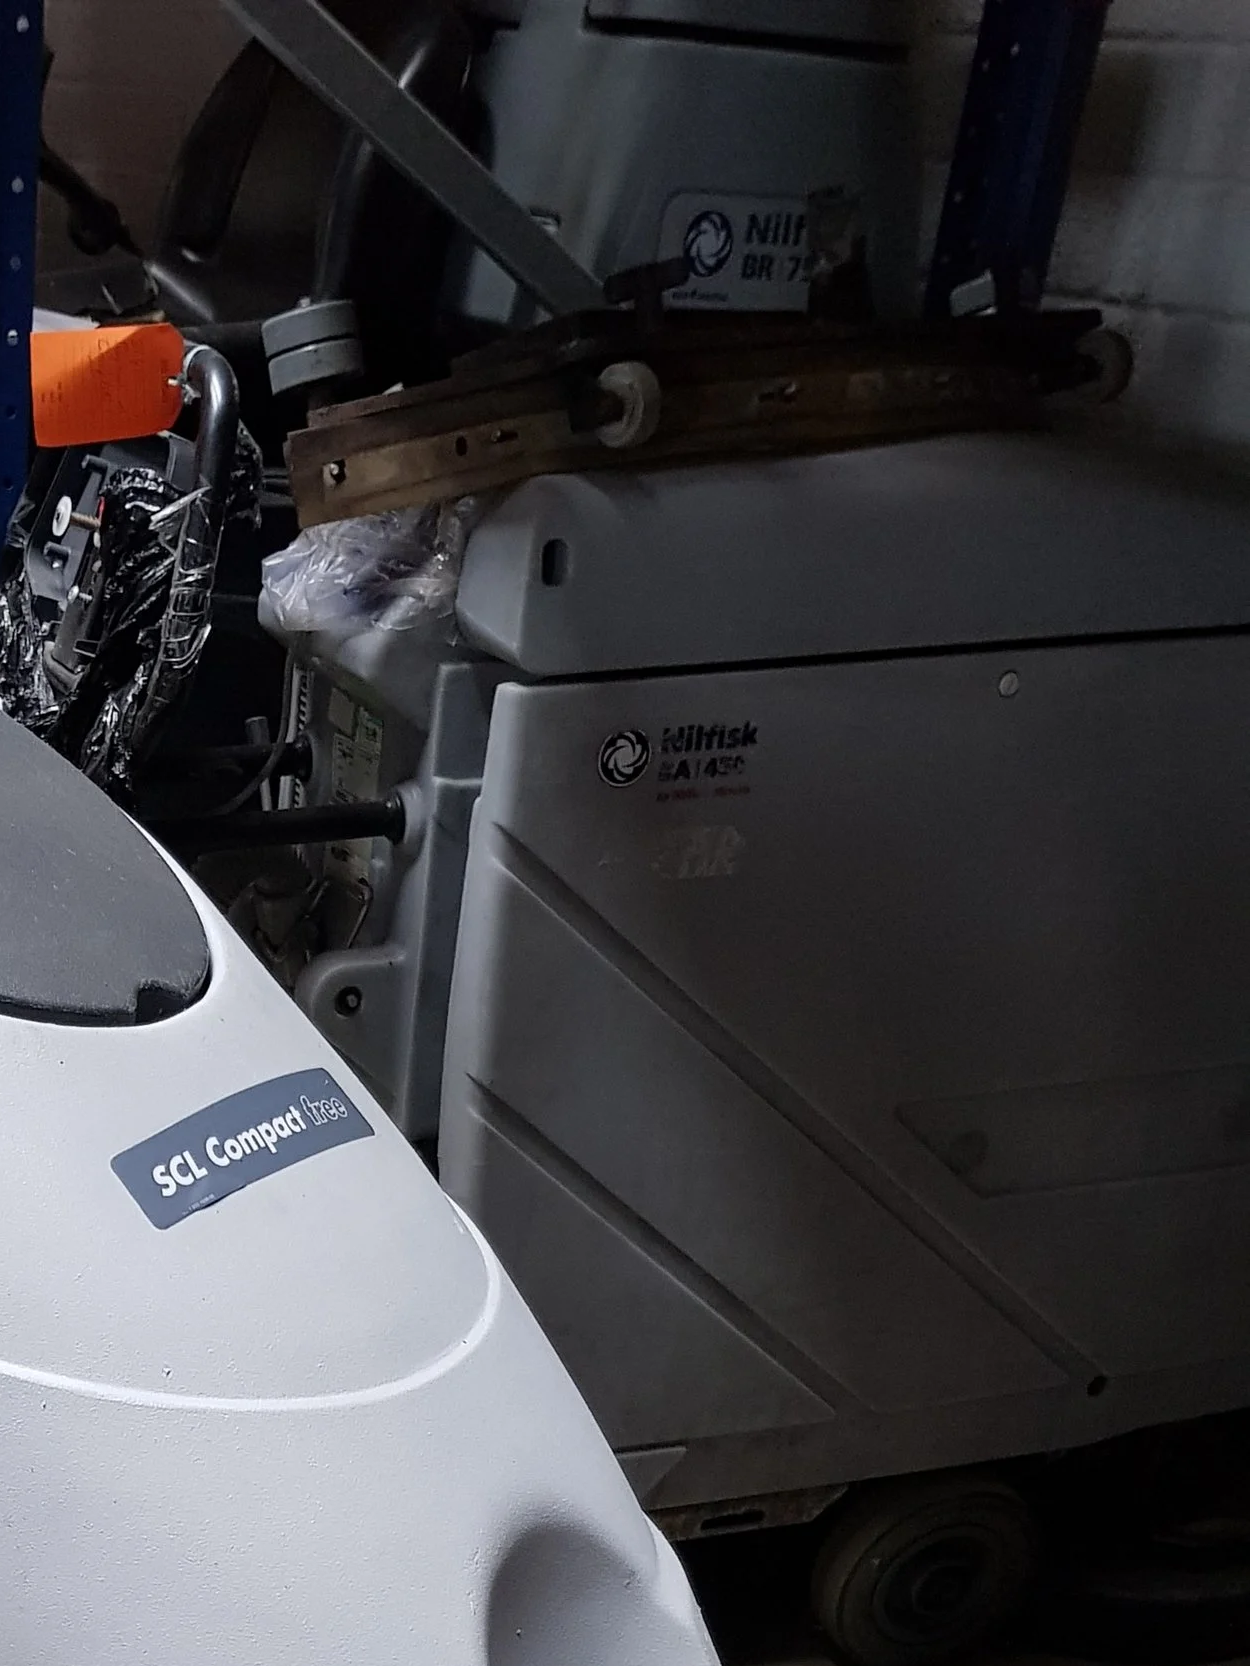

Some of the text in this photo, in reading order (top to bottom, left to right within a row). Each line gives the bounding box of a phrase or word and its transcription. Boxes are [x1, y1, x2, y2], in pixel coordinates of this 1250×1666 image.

[746, 212, 806, 247] Nilf
[741, 254, 773, 281] BR
[153, 1095, 348, 1197] SCL Compact free
